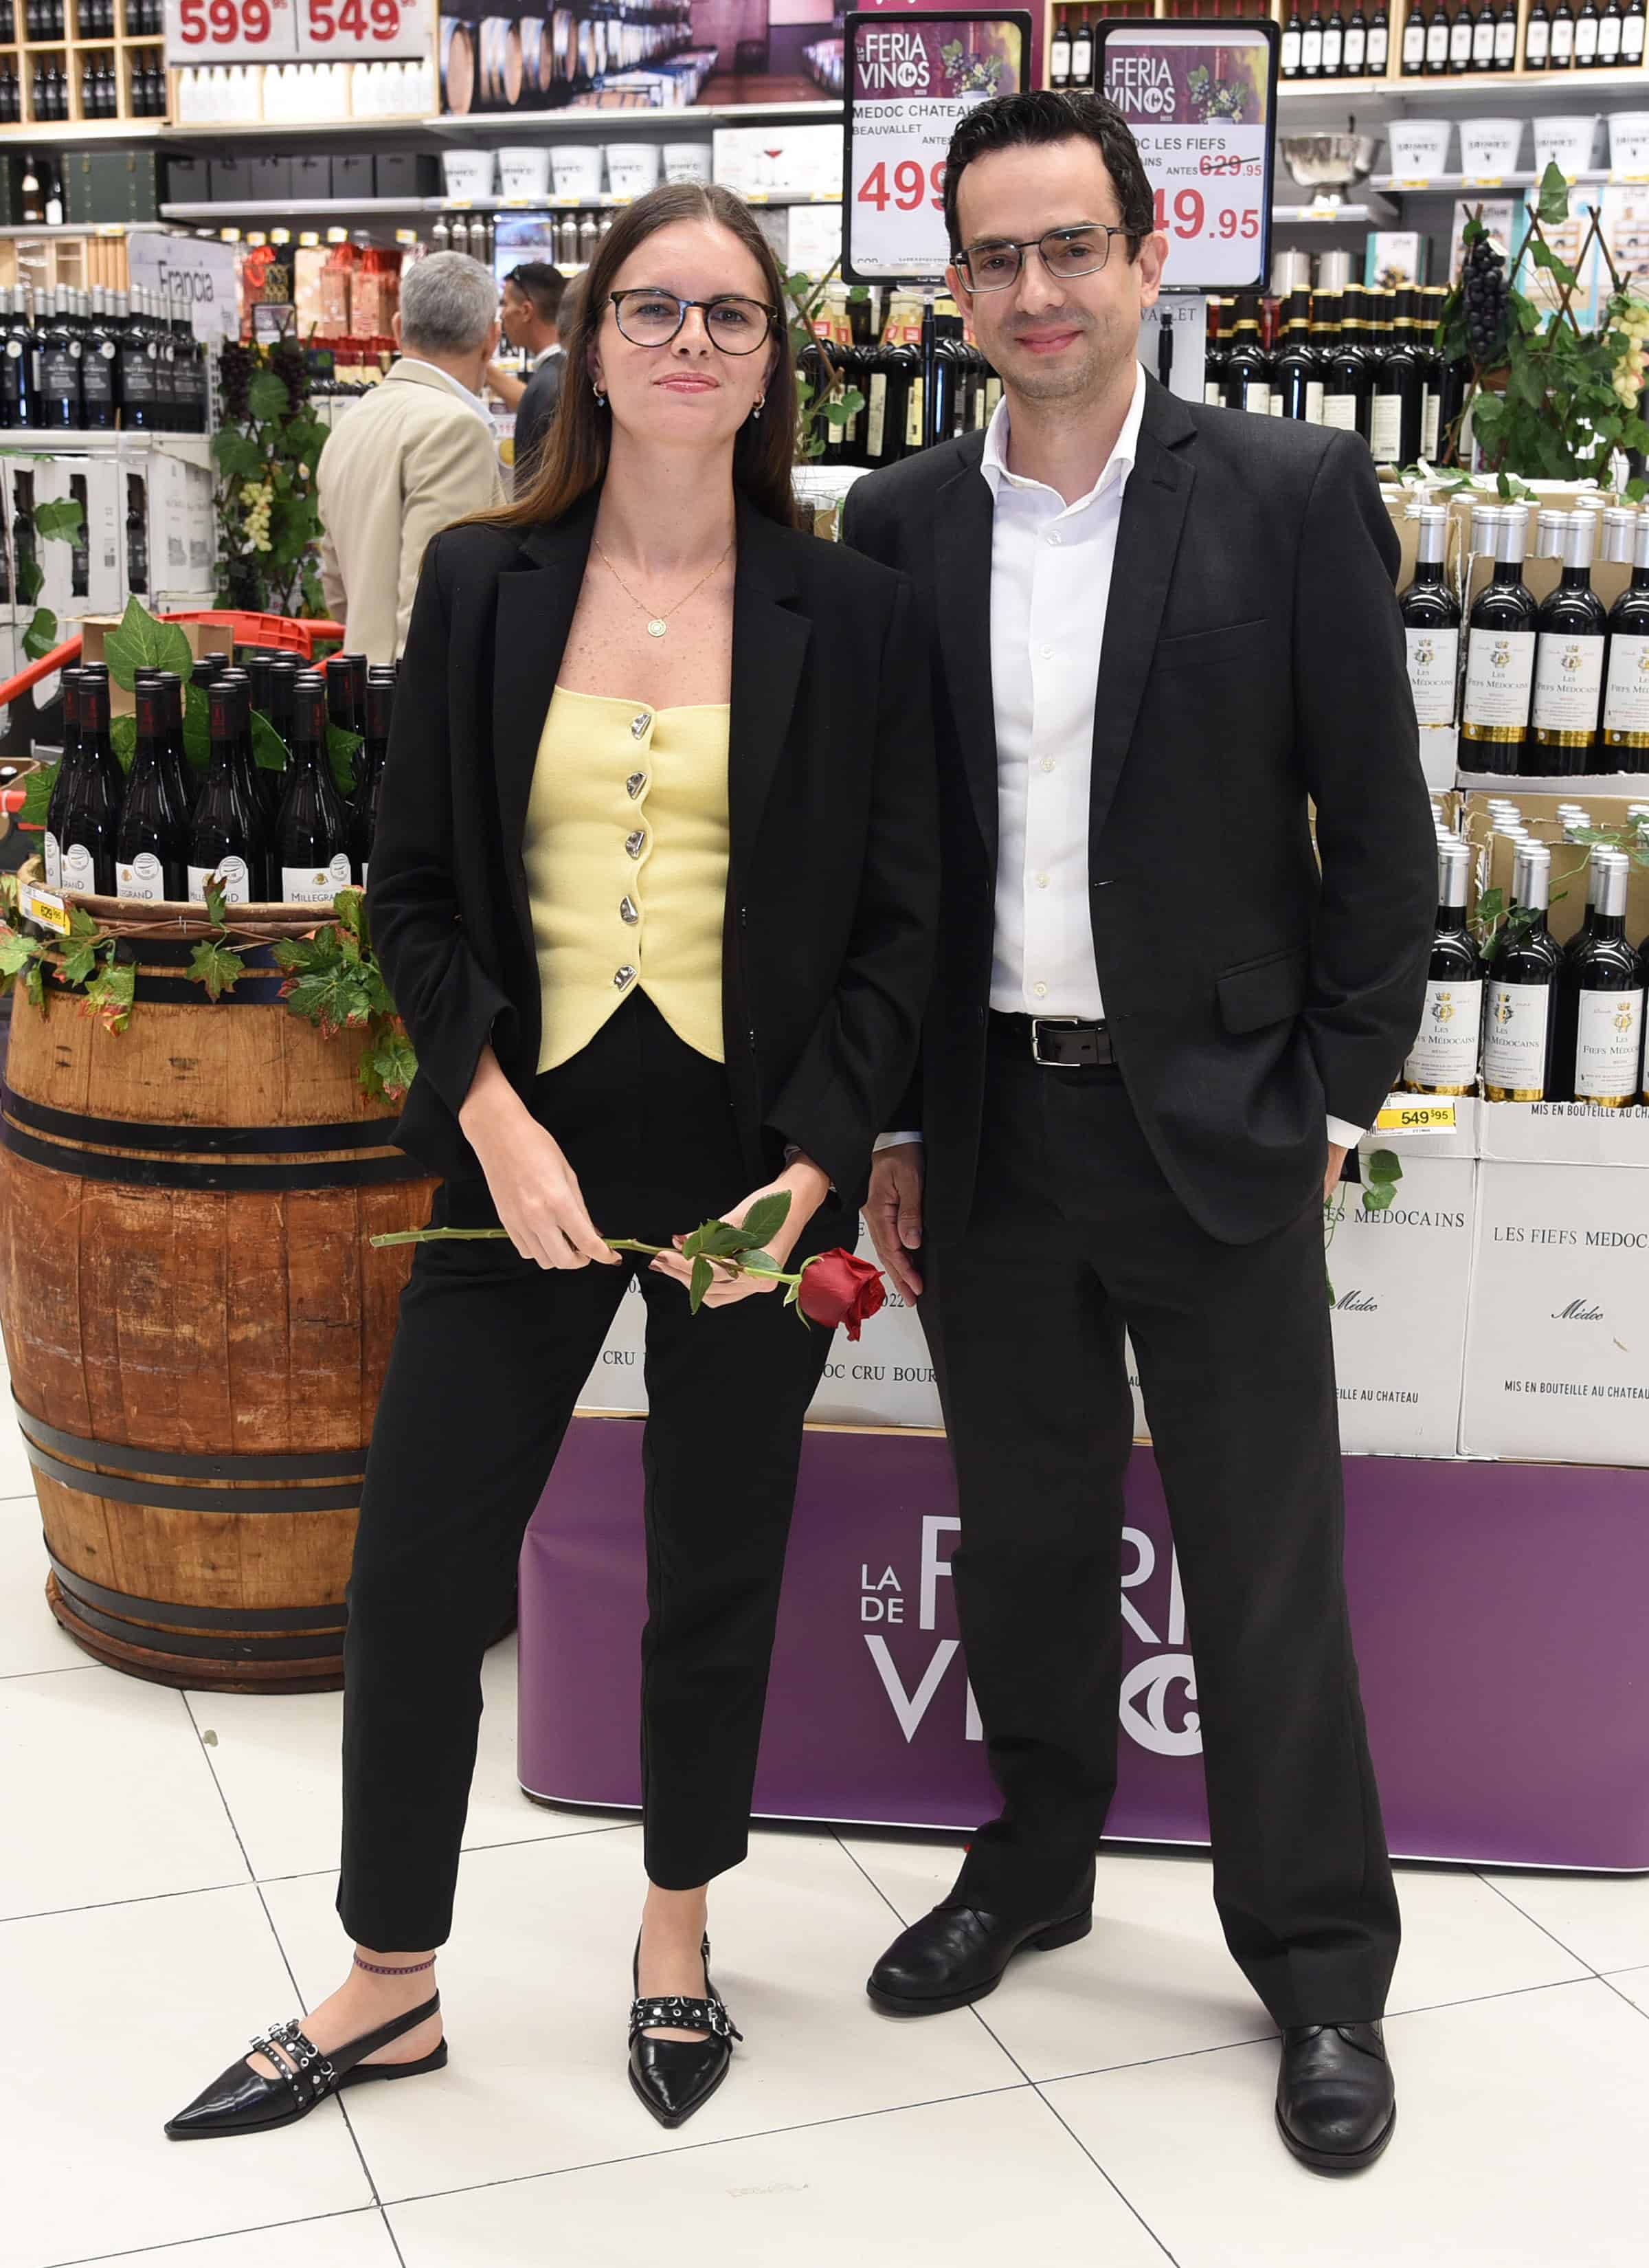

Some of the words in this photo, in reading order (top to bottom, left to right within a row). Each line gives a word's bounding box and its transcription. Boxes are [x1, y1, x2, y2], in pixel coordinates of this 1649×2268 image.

[180, 0, 271, 43] 599
[309, 0, 400, 42] 549
[866, 33, 927, 62] FERIA
[858, 61, 930, 89] VINOS
[1112, 58, 1173, 86] FERIA
[853, 106, 904, 118] MEDOC
[852, 124, 922, 135] BEAUVALLET
[1155, 138, 1182, 150] LES
[1187, 138, 1226, 150] FIEFS
[1166, 167, 1198, 175] ANTES
[1402, 1111, 1428, 1124] 549
[1531, 1104, 1548, 1115] MIS
[1551, 1104, 1564, 1115] EN
[1567, 1105, 1615, 1118] BOUTEILLE
[1619, 1108, 1632, 1118] AU
[1494, 1227, 1525, 1242] LES
[1531, 1229, 1578, 1245] FIEFS
[1585, 1231, 1649, 1249] MEDOC
[603, 1350, 635, 1365] CRU
[851, 1365, 885, 1380] CRU
[1360, 1390, 1373, 1401] AU
[1376, 1390, 1419, 1403] CHATEAU
[1505, 1380, 1521, 1392] MIS
[1525, 1381, 1537, 1393] EN
[1540, 1382, 1588, 1396] BOUTEILLE
[1591, 1385, 1604, 1397] AU
[1607, 1386, 1649, 1399] CHATEAU
[861, 1564, 901, 1592] LA
[861, 1597, 904, 1623] DE
